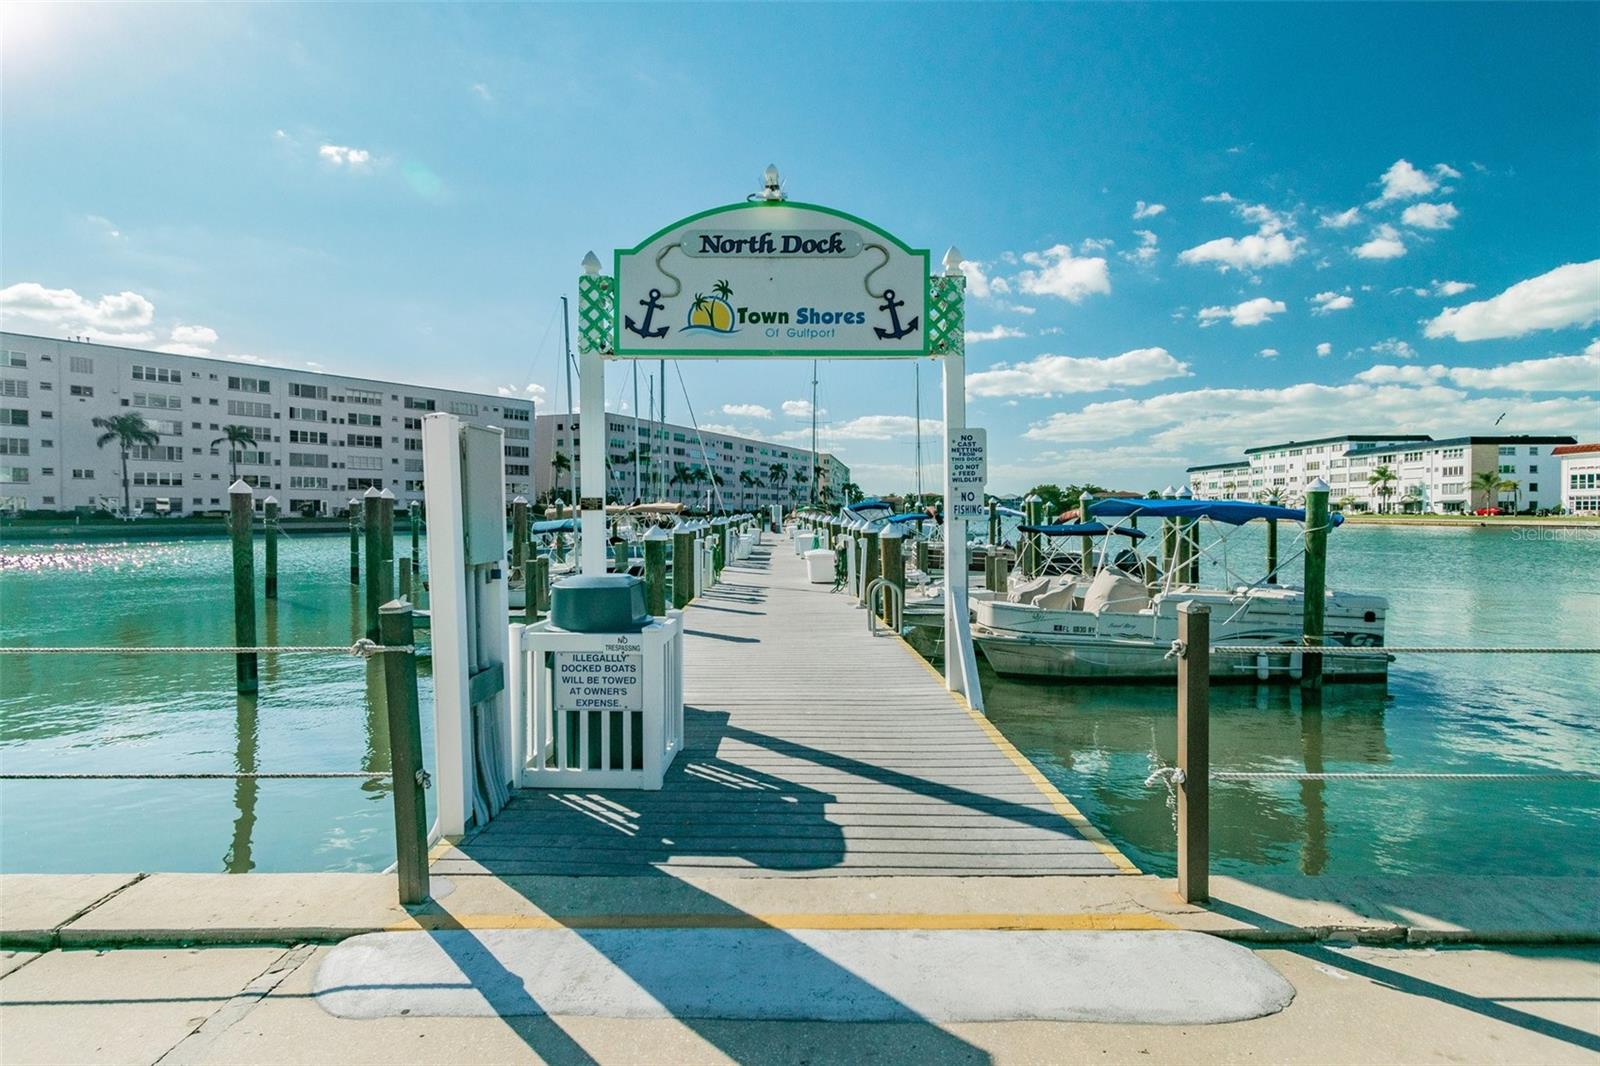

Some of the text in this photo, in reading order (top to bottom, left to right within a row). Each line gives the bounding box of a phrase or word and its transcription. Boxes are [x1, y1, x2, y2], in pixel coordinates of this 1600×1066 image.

[699, 232, 845, 254] North Dock
[736, 307, 866, 325] Town Shores
[765, 328, 836, 340] Of Gulfport
[960, 491, 975, 502] NO
[953, 504, 982, 515] FISHING
[561, 664, 637, 673] DOCKED BOATS
[561, 676, 637, 685] WILL BE TOWED
[569, 687, 582, 696] AT
